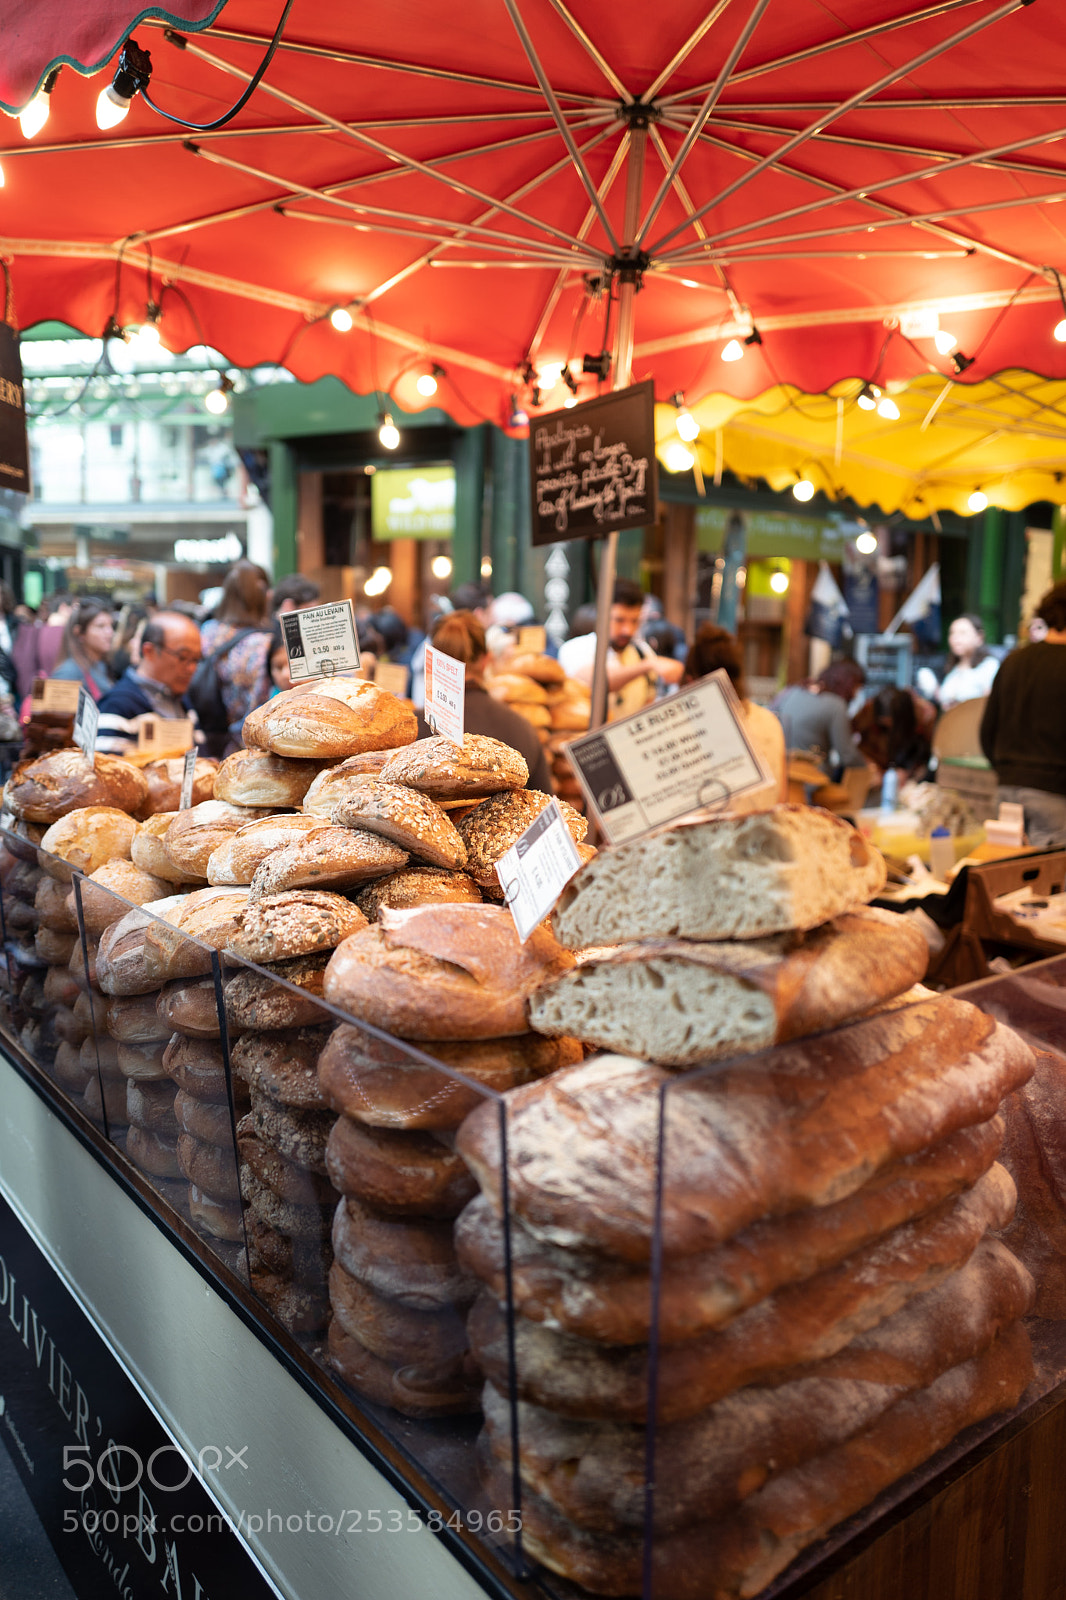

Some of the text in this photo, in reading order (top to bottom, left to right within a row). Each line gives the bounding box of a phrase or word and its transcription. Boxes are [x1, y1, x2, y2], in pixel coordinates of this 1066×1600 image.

[303, 612, 315, 620] PAIN
[324, 606, 344, 615] LEVAIN
[628, 720, 645, 736] LE
[648, 695, 701, 725] RUSTIC
